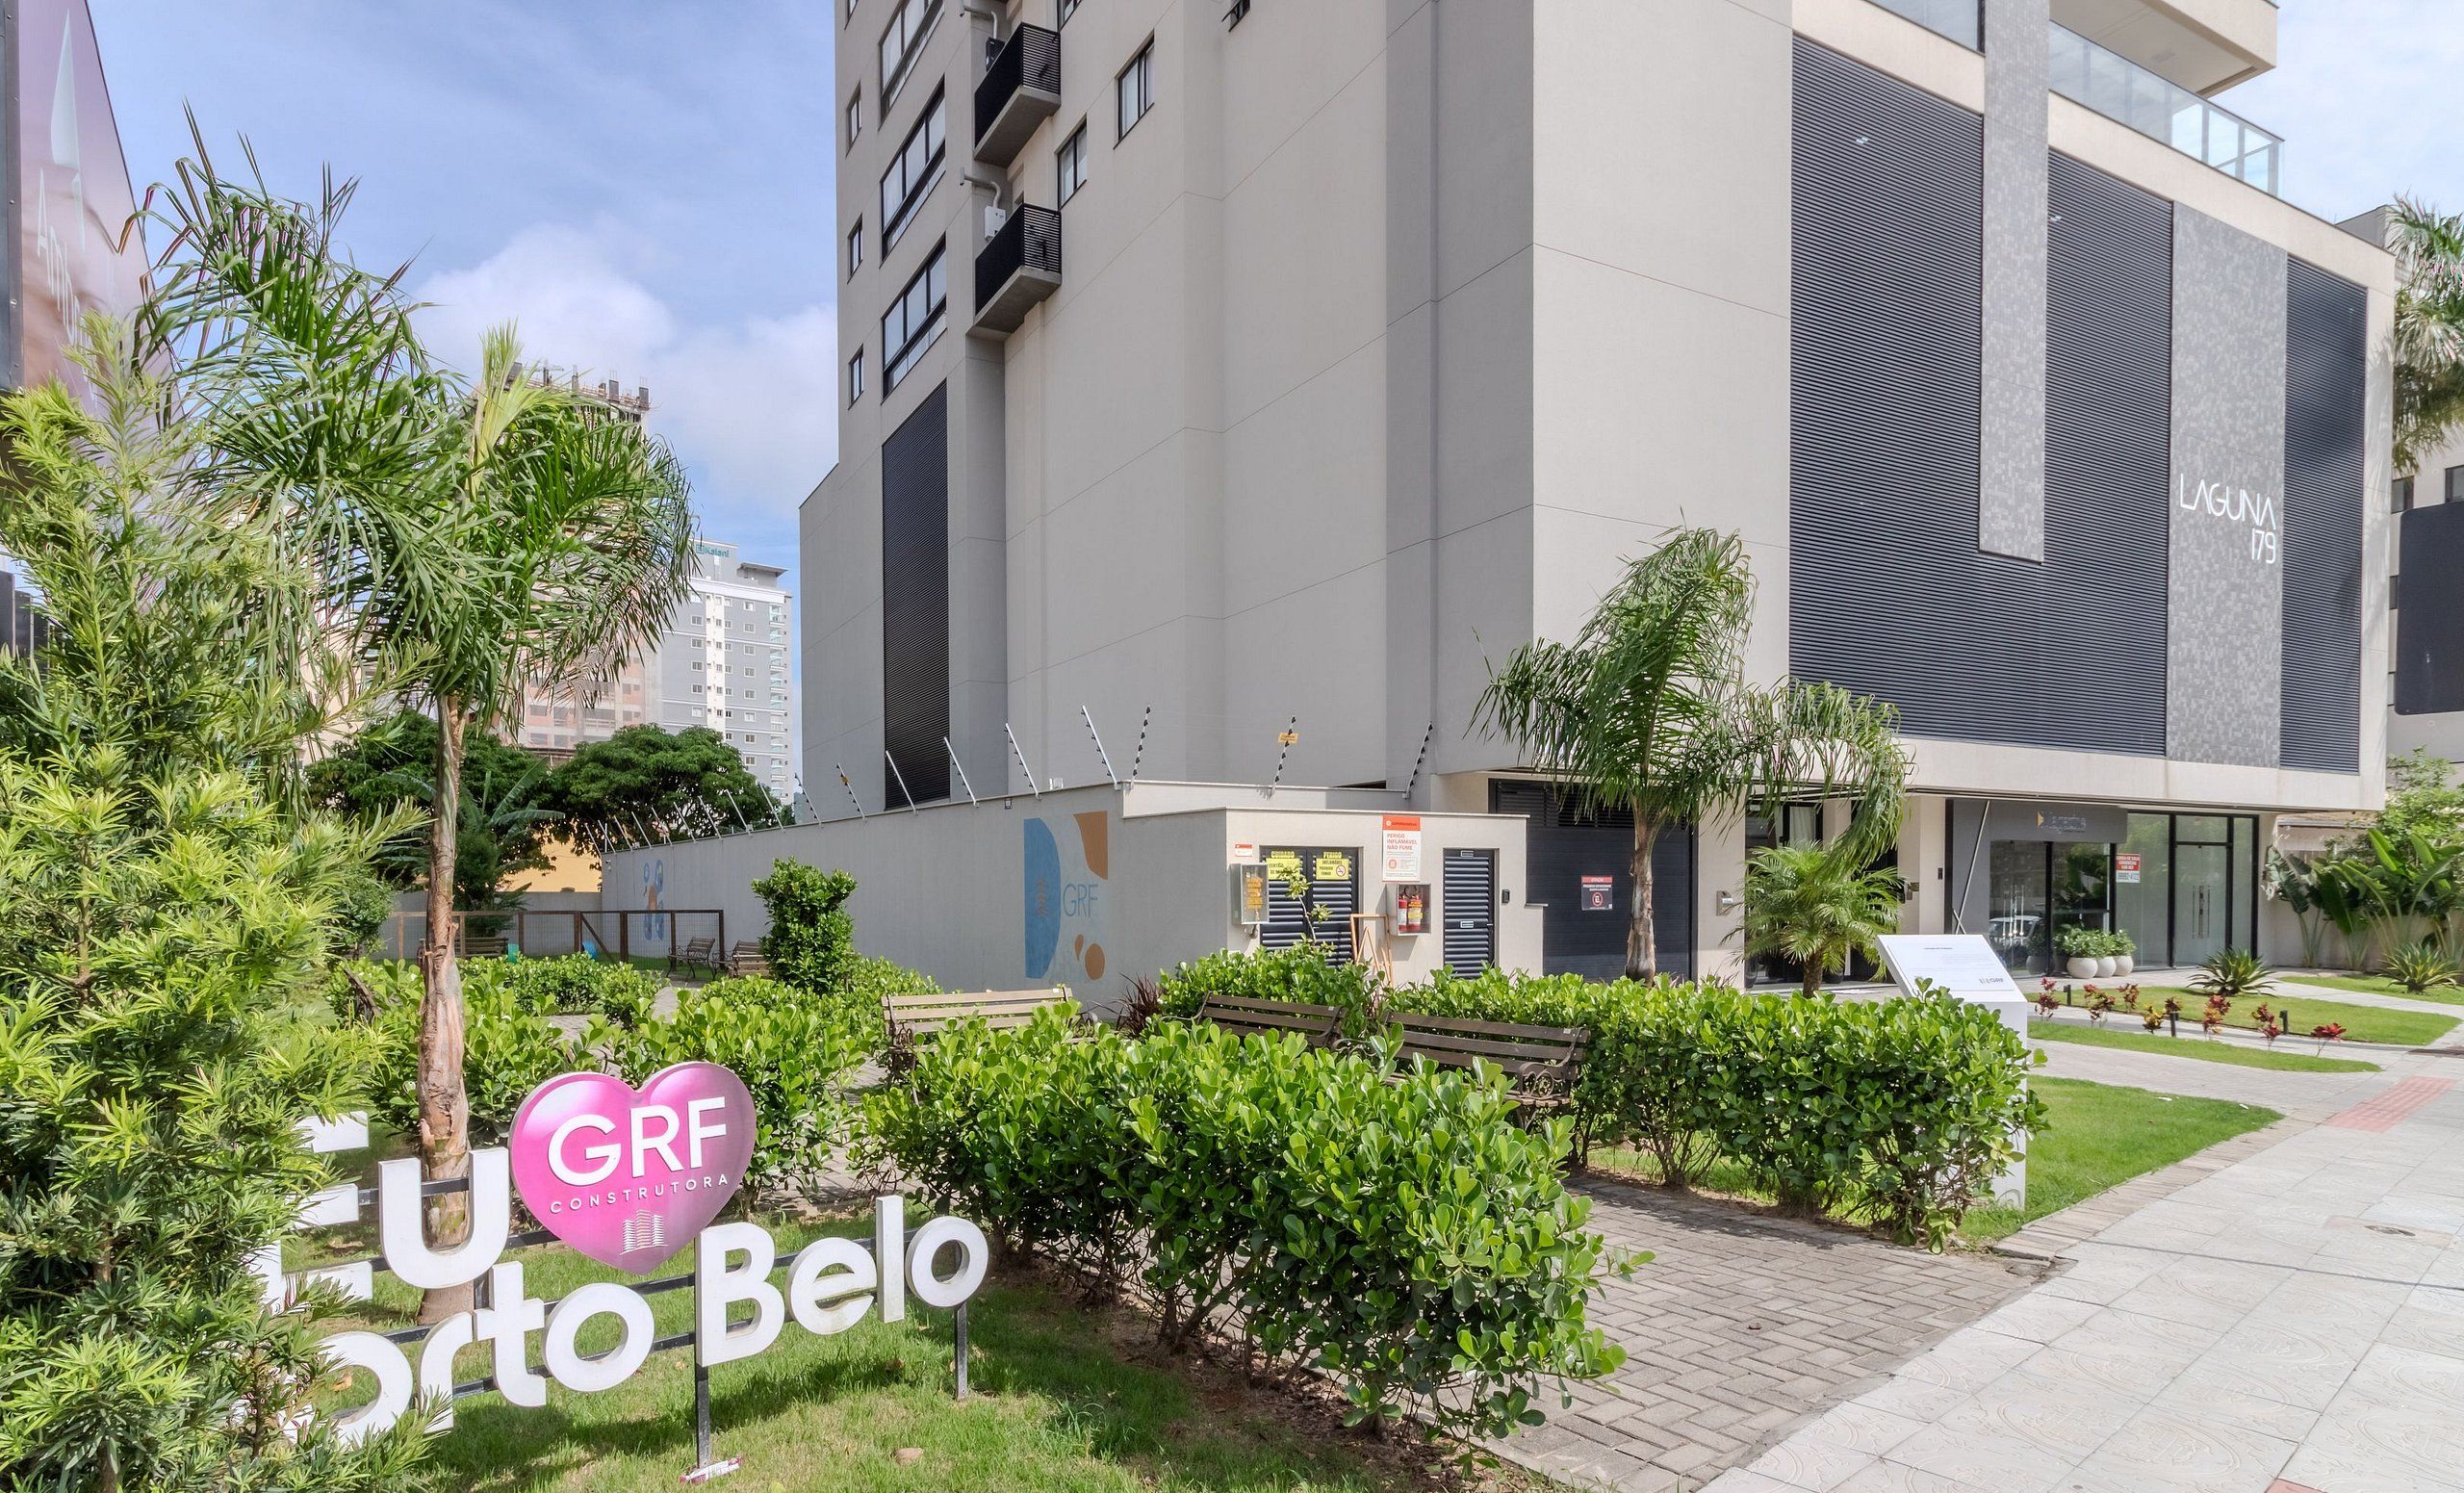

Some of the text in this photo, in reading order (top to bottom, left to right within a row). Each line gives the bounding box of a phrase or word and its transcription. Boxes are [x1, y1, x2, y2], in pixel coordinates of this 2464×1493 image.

[2179, 473, 2277, 530] LAGUNA
[2251, 528, 2276, 564] 179
[1063, 884, 1098, 917] GRF
[547, 1096, 727, 1187] GRF
[550, 1173, 729, 1214] CONSTRUTORA
[219, 1195, 988, 1452] orto Belo
